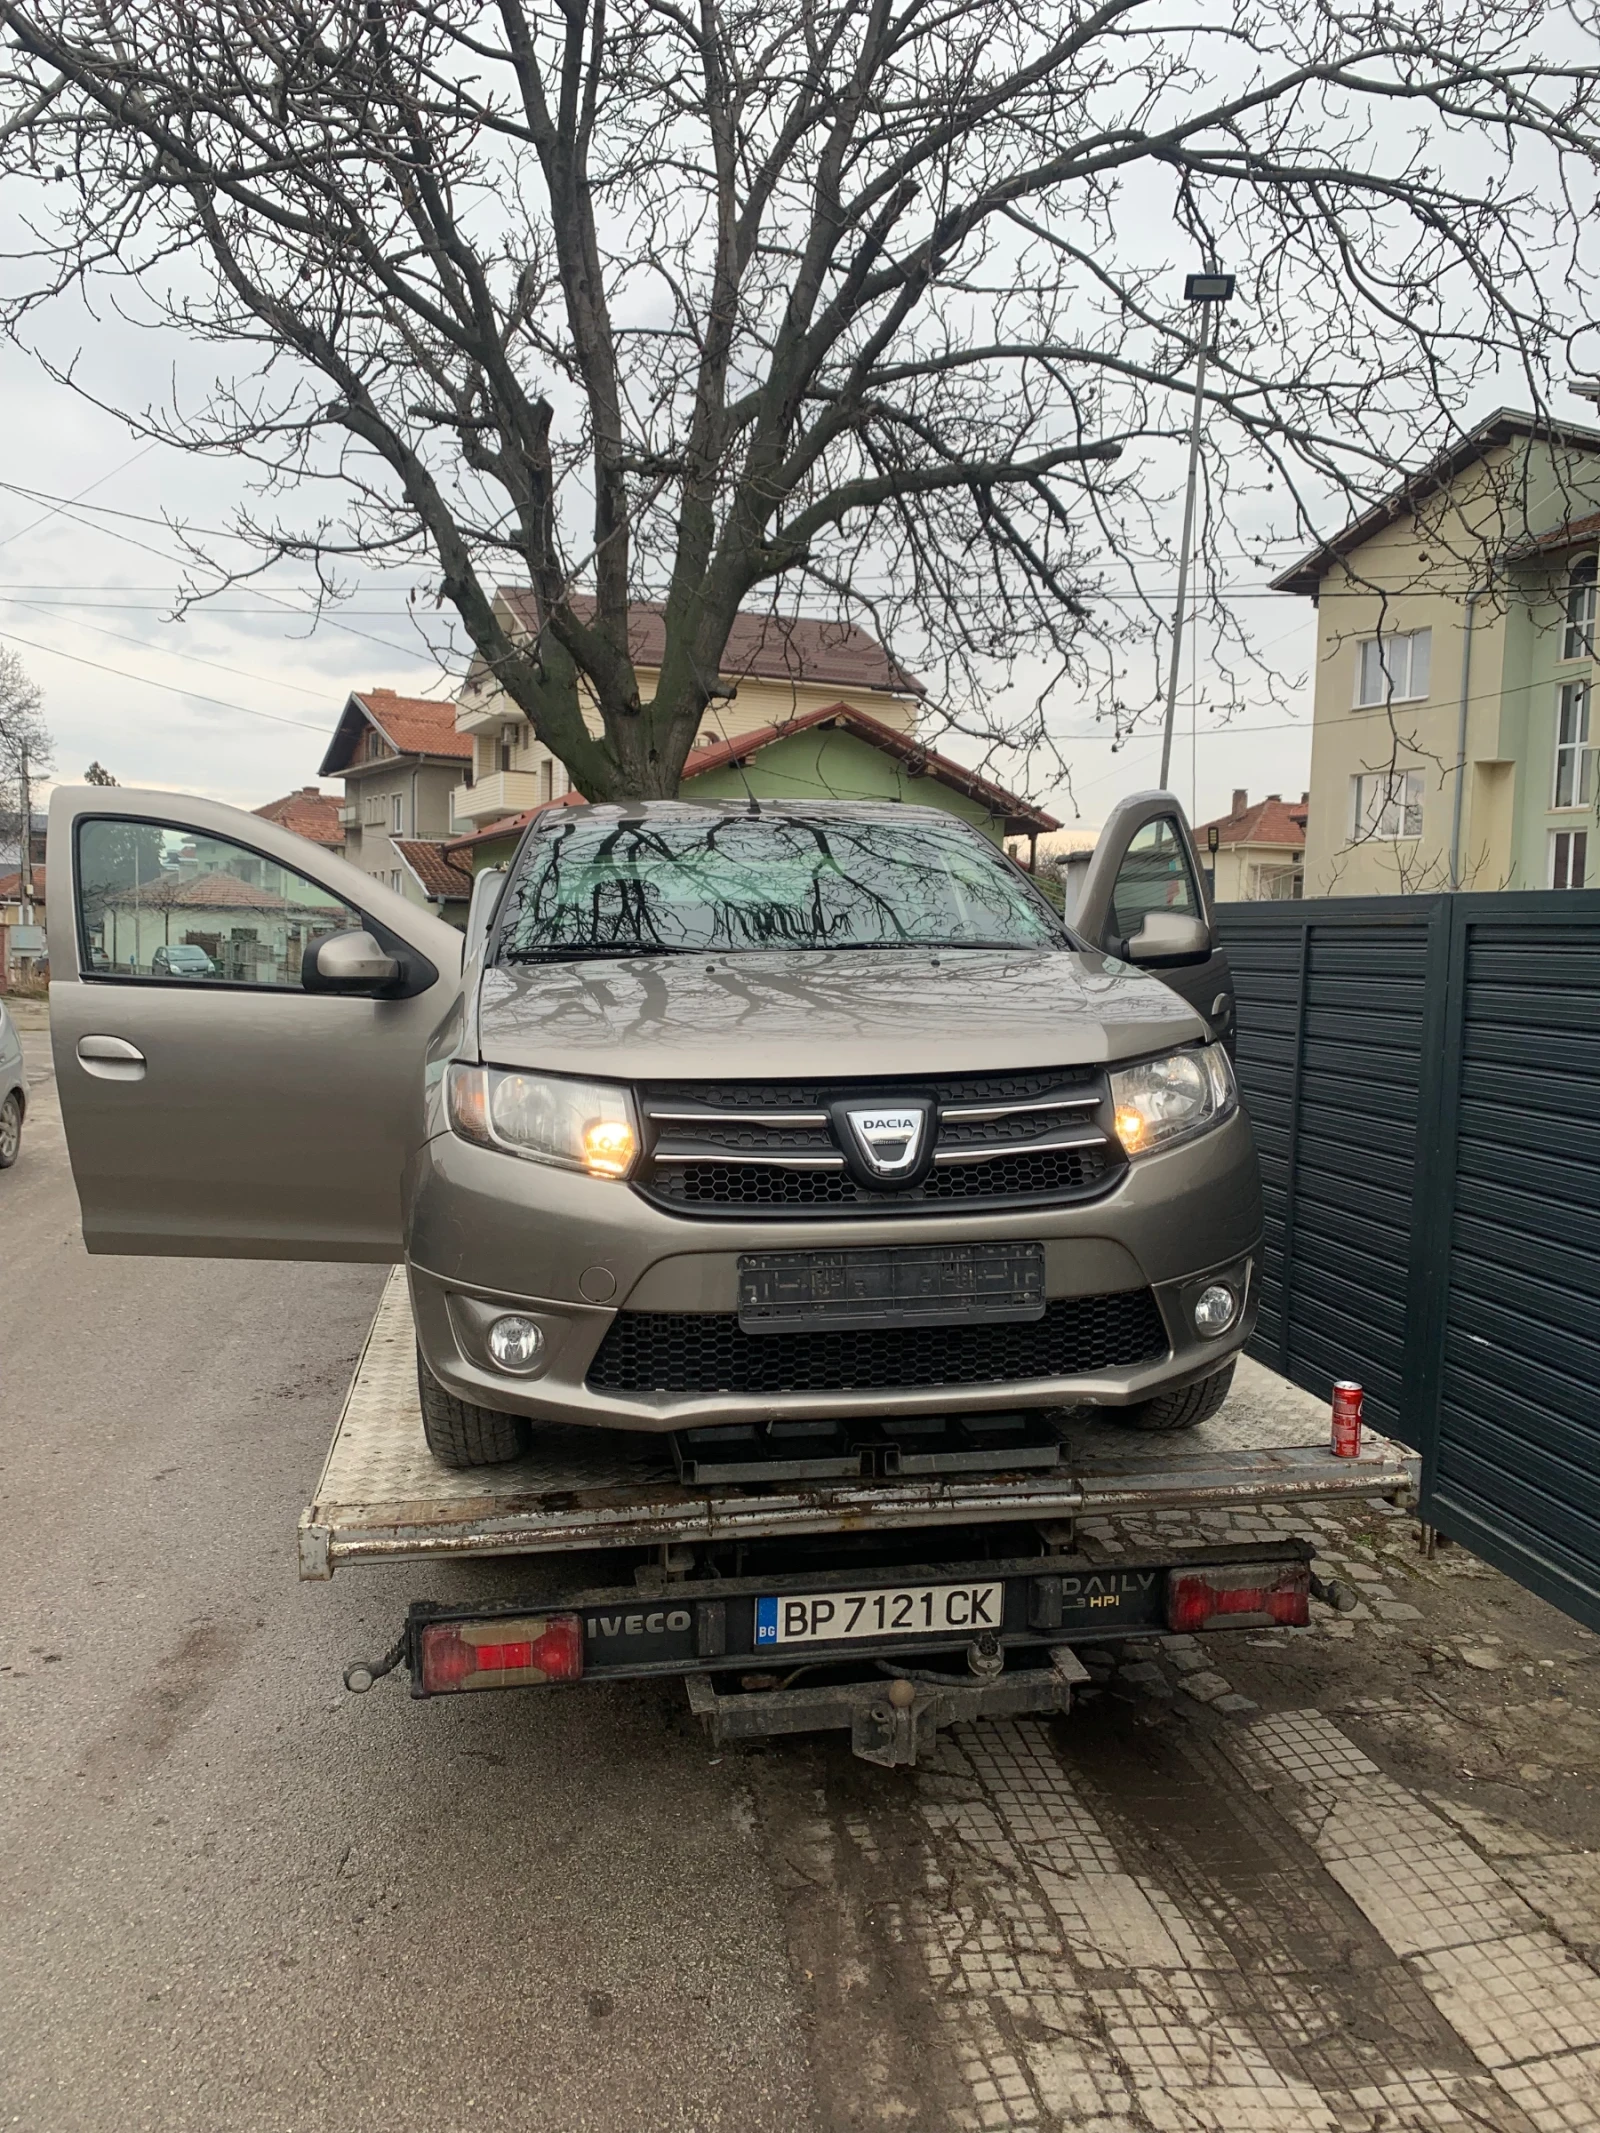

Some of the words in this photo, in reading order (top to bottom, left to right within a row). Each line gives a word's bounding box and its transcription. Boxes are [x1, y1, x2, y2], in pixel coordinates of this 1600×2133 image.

[863, 1119, 914, 1129] DACIA
[1062, 1573, 1156, 1596] DAILY
[1090, 1595, 1120, 1607] HPI
[784, 1600, 835, 1637] BP
[844, 1592, 933, 1632] 7121
[946, 1588, 994, 1625] CK
[587, 1610, 692, 1638] IVECO
[759, 1626, 775, 1637] BG
